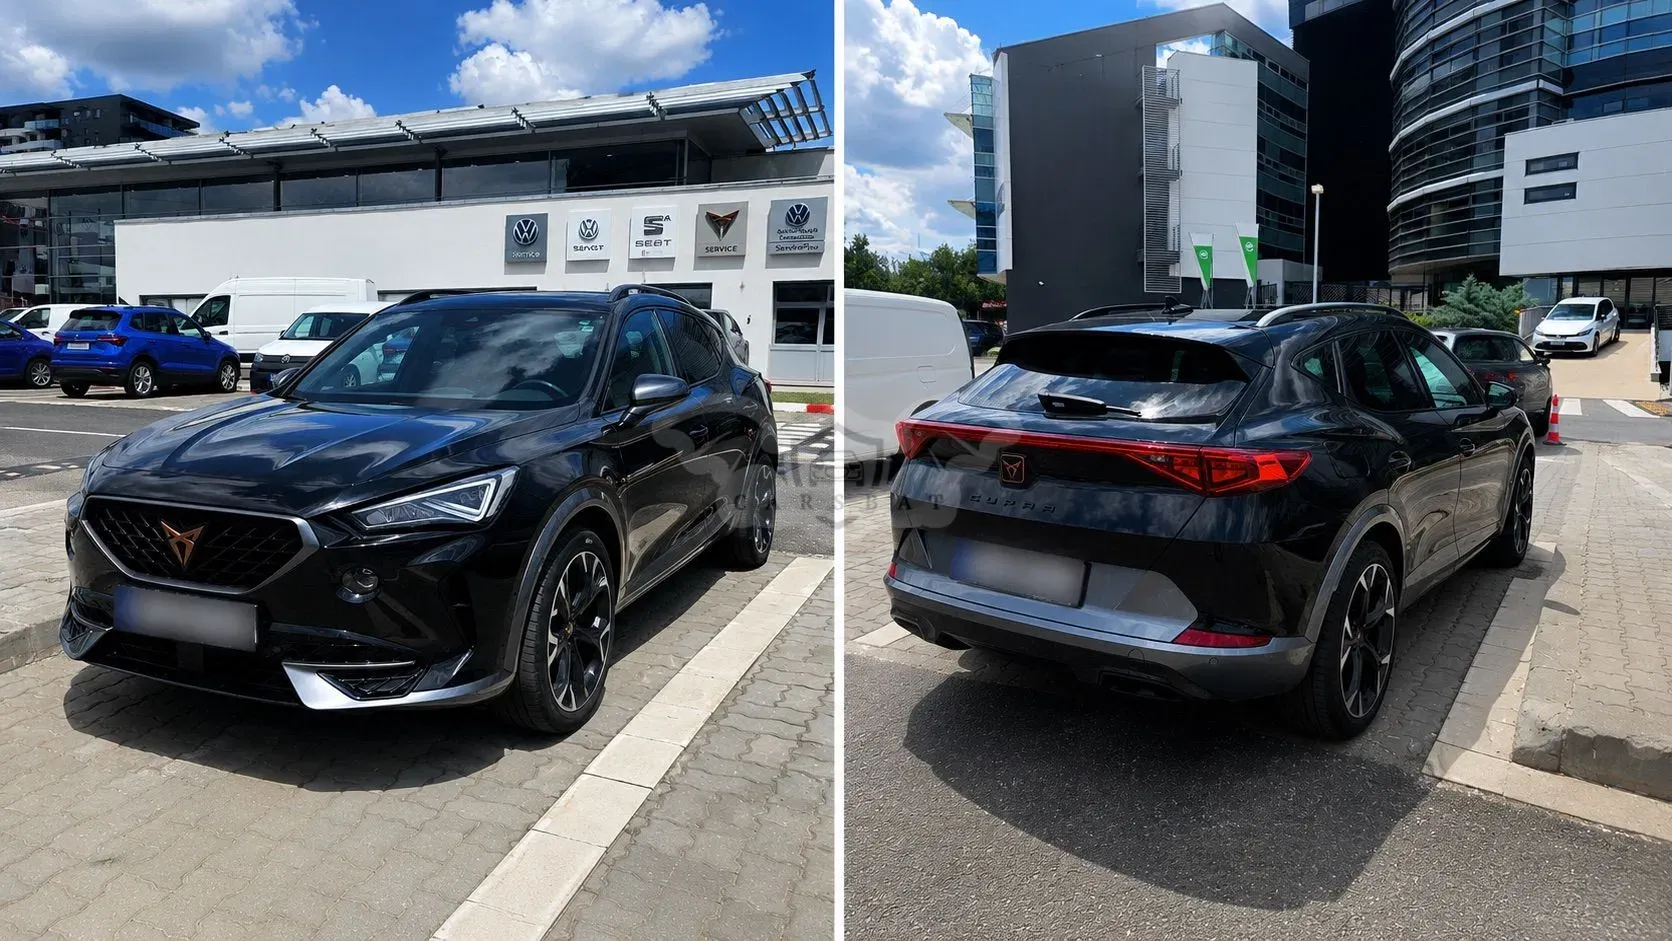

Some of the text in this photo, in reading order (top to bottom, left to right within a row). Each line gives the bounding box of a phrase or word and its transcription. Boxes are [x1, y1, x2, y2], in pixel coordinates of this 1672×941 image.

[635, 239, 672, 248] SEAT
[705, 245, 738, 254] SERVICE
[969, 495, 1056, 513] CUPRA
